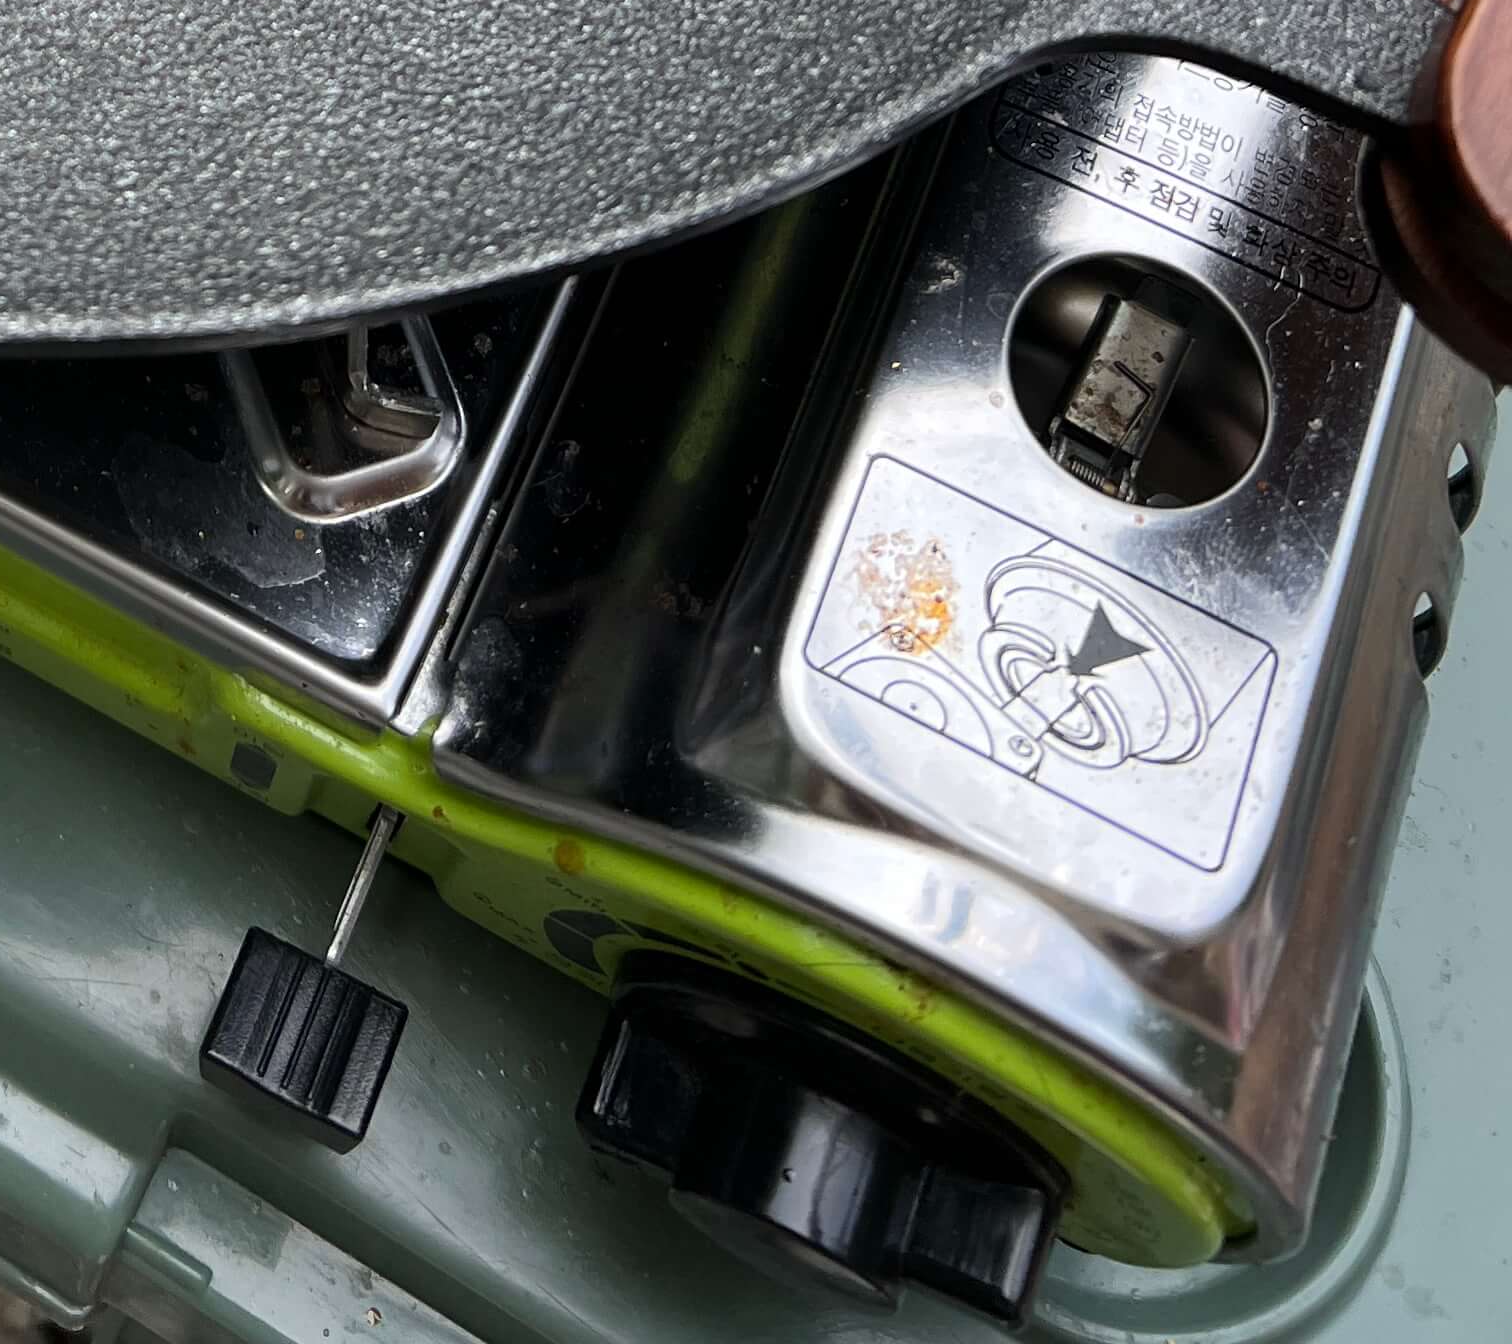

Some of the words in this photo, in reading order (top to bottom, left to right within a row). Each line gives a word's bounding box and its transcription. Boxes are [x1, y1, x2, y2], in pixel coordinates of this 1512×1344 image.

[1133, 93, 1245, 162] 접속방법이
[1113, 164, 1141, 193] 후
[1150, 179, 1201, 223] 점검
[1207, 205, 1233, 239] 및
